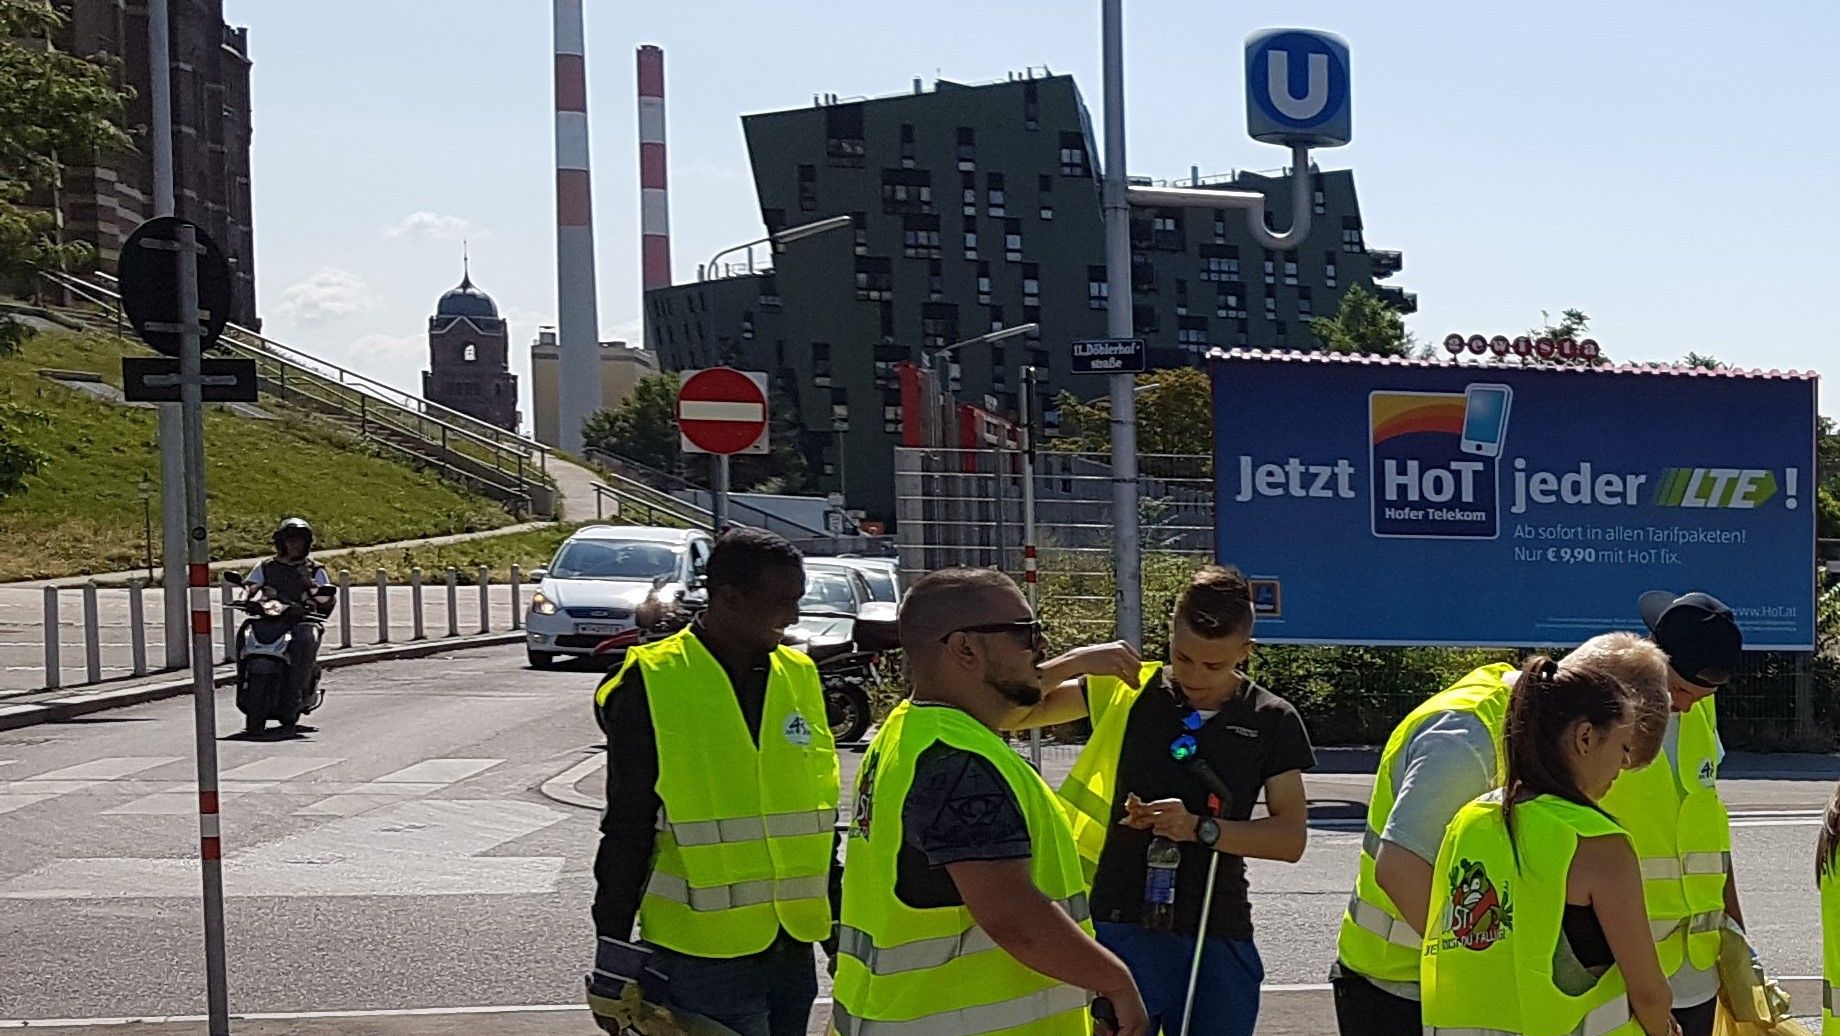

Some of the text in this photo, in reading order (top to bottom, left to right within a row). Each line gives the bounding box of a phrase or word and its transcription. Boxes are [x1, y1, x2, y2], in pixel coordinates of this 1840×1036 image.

[1267, 49, 1329, 120] U
[1448, 336, 1597, 357] gewista
[1235, 454, 1356, 502] Jetzt
[1384, 459, 1484, 503] HoT
[1510, 457, 1647, 514] jeder
[1680, 467, 1768, 509] LTE
[1384, 506, 1486, 521] Hofer Telekom
[1513, 523, 1746, 545] Ab sofort in allen Tarifpaketen!
[1513, 547, 1541, 561] Nur
[1547, 547, 1558, 562] €
[1560, 547, 1596, 565] 9,90
[1599, 549, 1624, 563] mit
[1627, 549, 1658, 564] HoT
